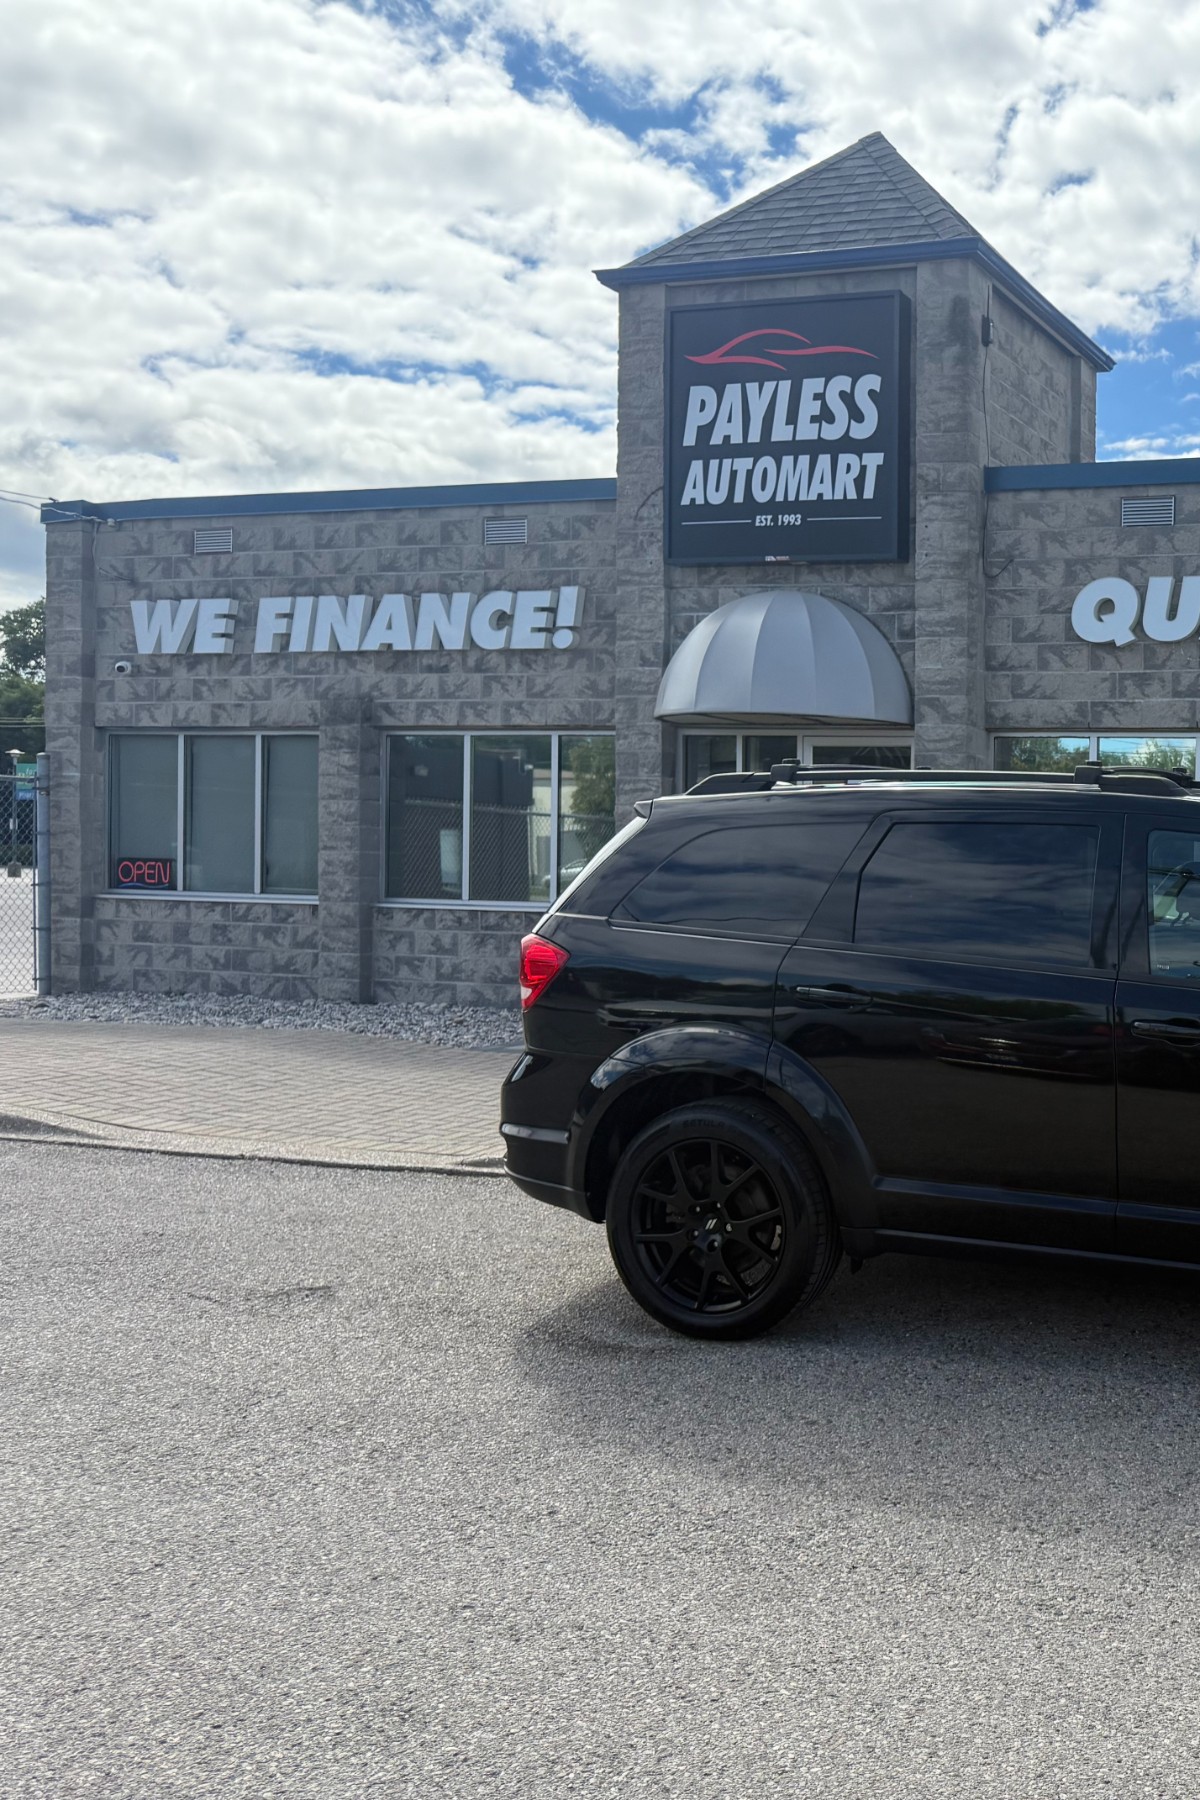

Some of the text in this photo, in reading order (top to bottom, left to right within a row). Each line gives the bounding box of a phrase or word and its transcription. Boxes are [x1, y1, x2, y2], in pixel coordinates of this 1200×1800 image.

[682, 374, 882, 447] PAYLESS
[680, 452, 884, 506] AUTOMART
[755, 513, 802, 527] EST. 1993
[130, 585, 586, 655] WE FINANCE!
[118, 861, 170, 884] OPEN
